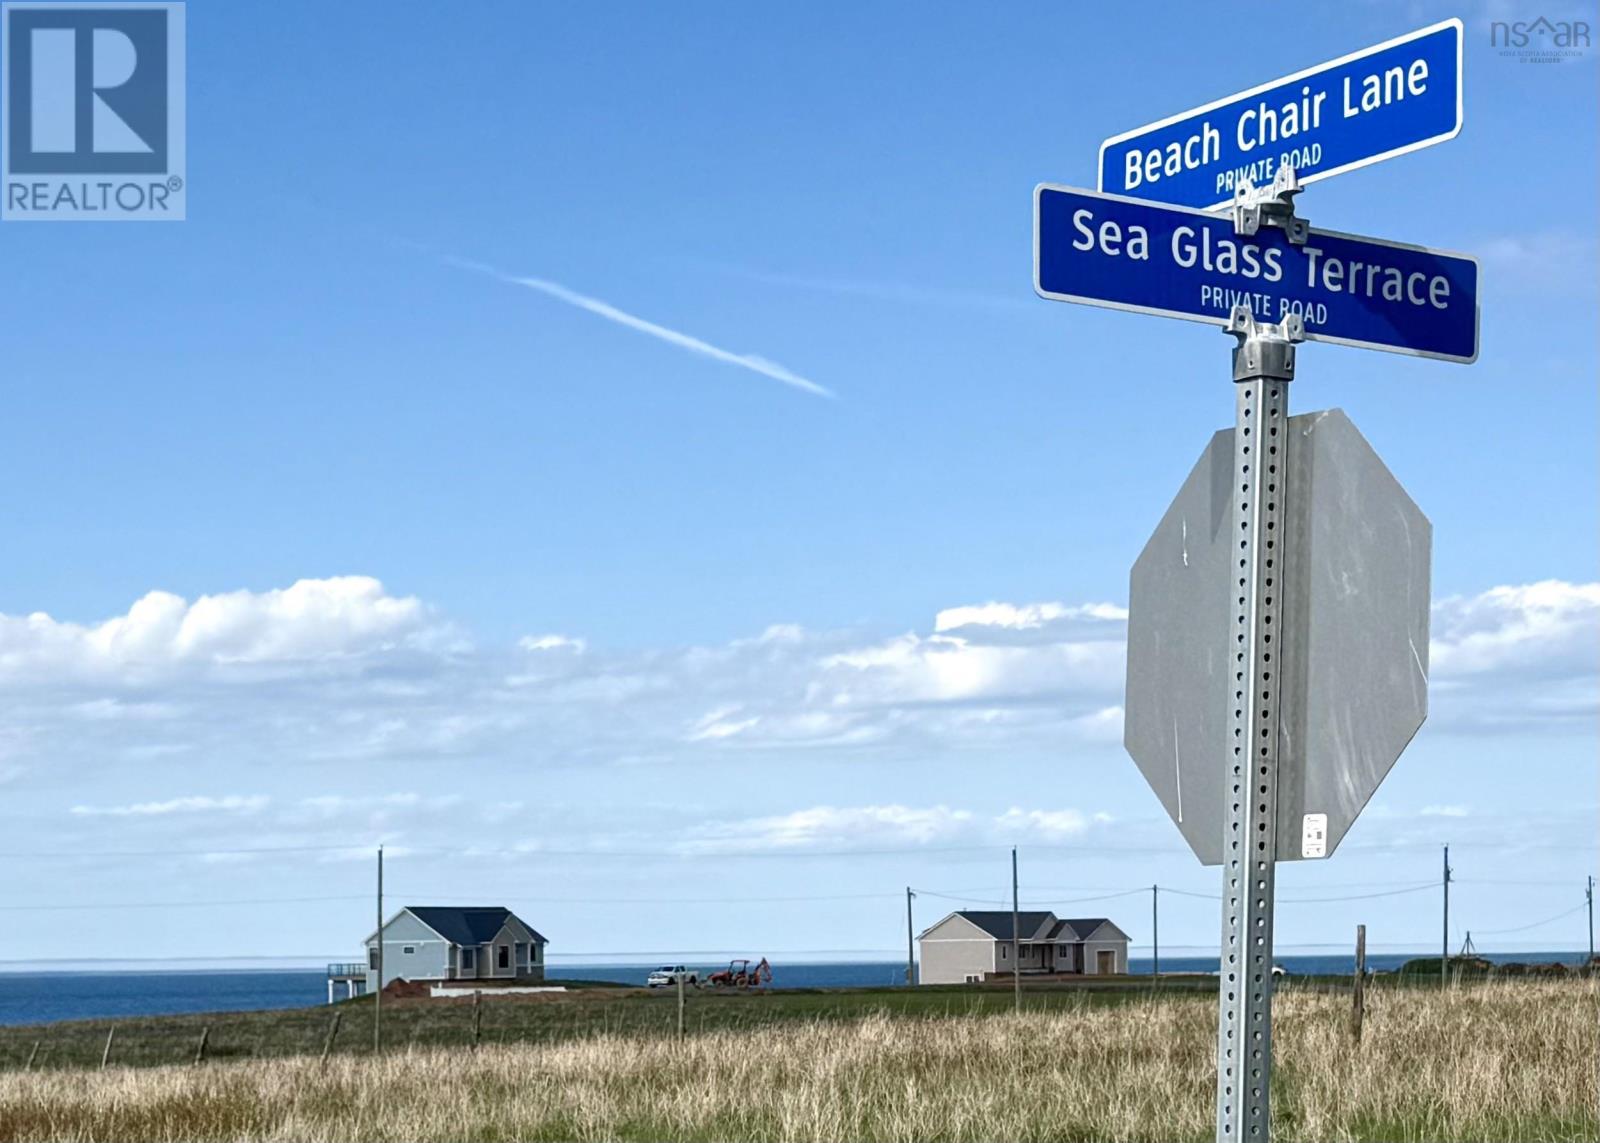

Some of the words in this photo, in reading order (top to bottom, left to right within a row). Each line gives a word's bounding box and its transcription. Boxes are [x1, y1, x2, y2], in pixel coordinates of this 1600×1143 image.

[1124, 122, 1220, 190] Beach
[1237, 86, 1326, 152] Chair
[1343, 58, 1429, 118] Lane
[1216, 157, 1274, 194] PRIVATE
[1280, 143, 1322, 170] ROAD
[1072, 209, 1149, 261] Sea
[1171, 226, 1283, 282] Glass
[1303, 246, 1451, 309] Terrace
[1201, 285, 1272, 316] PRIVATE
[1280, 298, 1327, 325] ROAD
